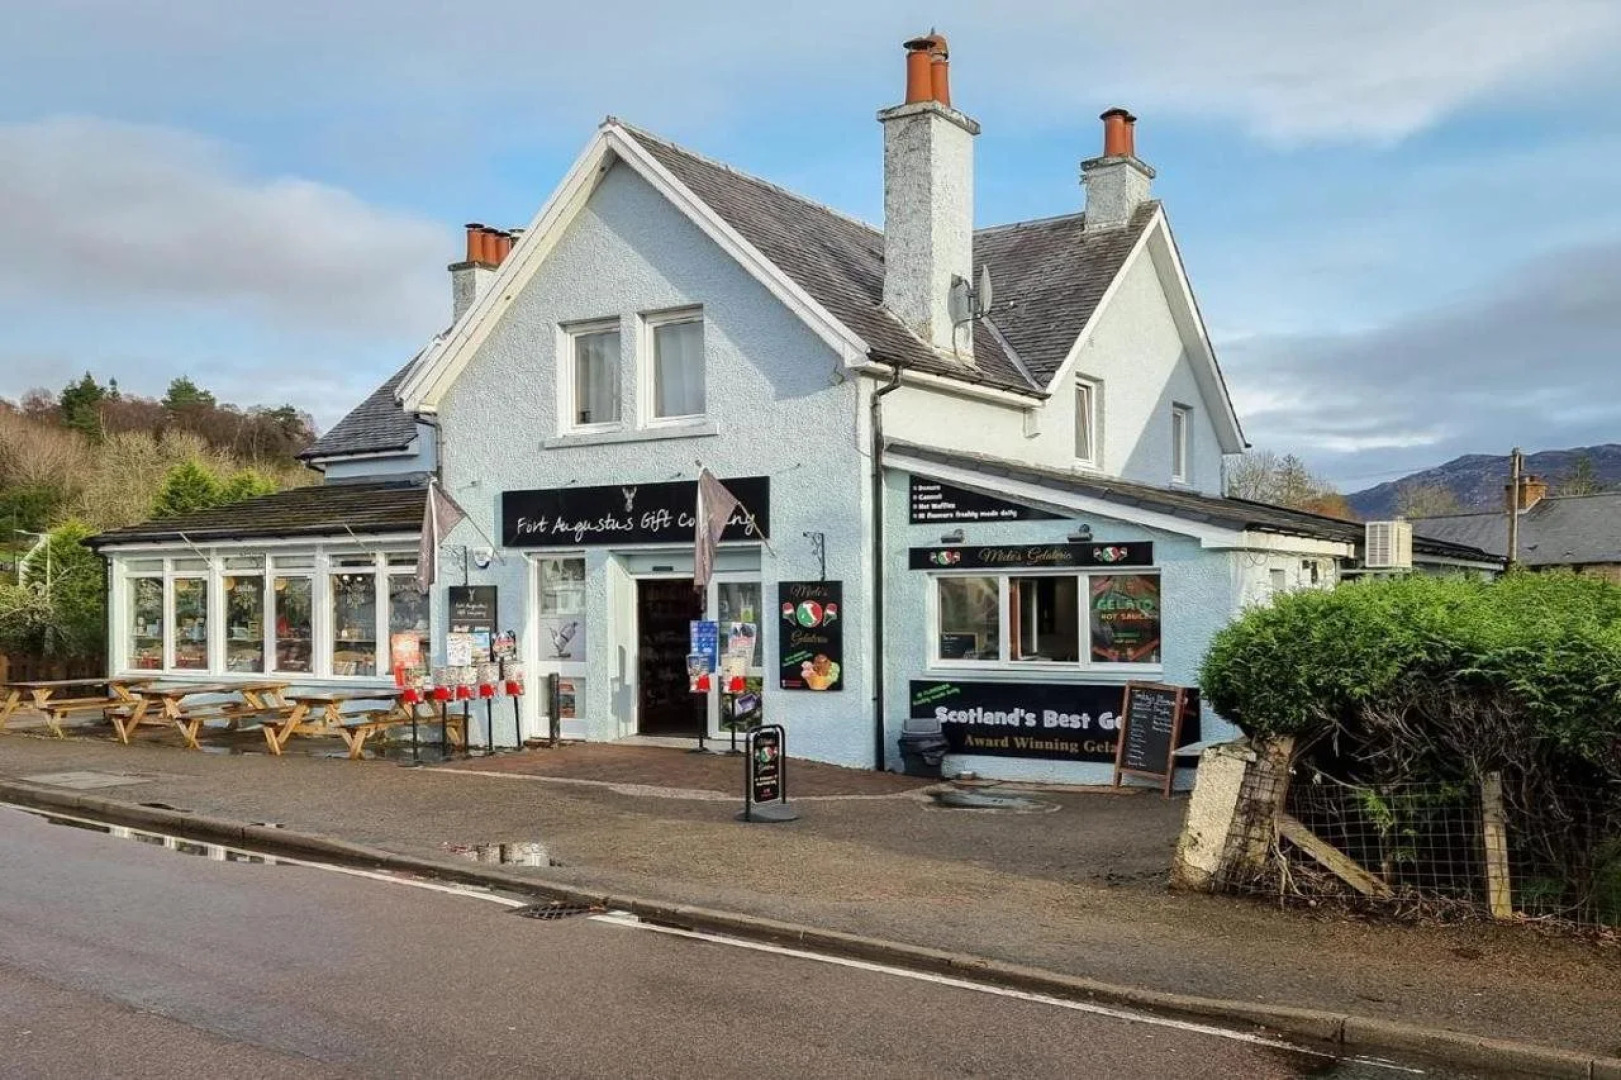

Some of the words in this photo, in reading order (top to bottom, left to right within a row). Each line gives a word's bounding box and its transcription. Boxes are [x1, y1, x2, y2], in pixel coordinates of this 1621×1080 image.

[1000, 509, 1017, 518] daily
[517, 516, 549, 534] Fort
[551, 513, 633, 542] Augustus
[640, 508, 673, 532] Gift
[678, 512, 755, 536] Cony
[935, 706, 1036, 727] Scotland's
[1043, 709, 1091, 729] Best
[964, 734, 1009, 748] Award
[1013, 736, 1079, 753] Winning
